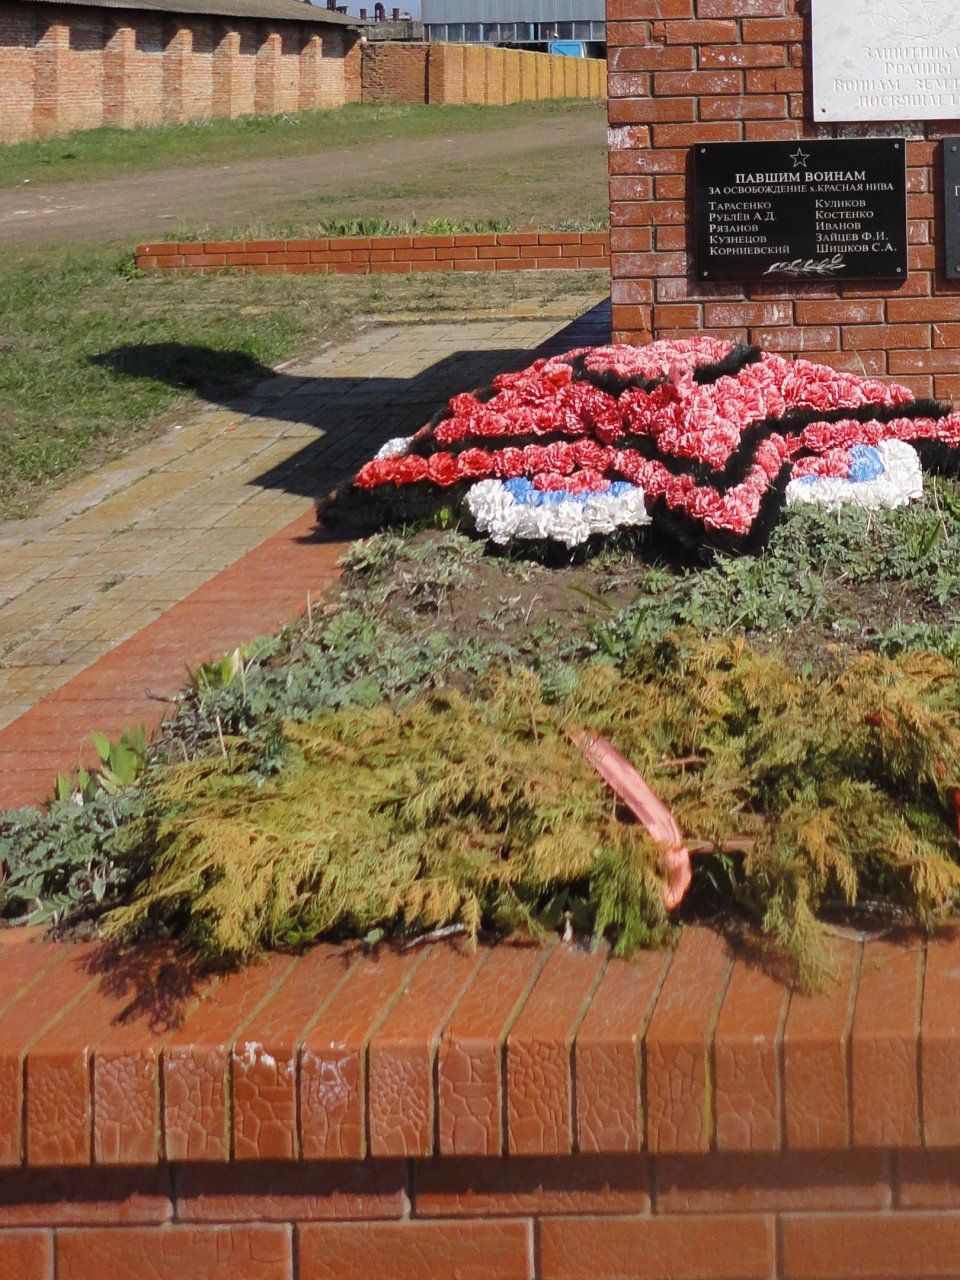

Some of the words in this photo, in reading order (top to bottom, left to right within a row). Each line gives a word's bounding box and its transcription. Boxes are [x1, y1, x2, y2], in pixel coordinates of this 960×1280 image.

[736, 172, 800, 183] ПАВШИМ
[805, 171, 866, 182] ВОИНАМ
[724, 185, 807, 194] ОСВОБОЖДЕНИЕ
[866, 183, 893, 191] НИВА
[708, 202, 771, 210] ТАРАСЕНКО
[815, 199, 866, 208] КУЛИКОВ
[816, 211, 874, 219] КОСТЕНКО
[709, 224, 758, 232] РЯЗАНОВ
[816, 222, 861, 230] ИВАНОВ
[710, 236, 767, 244] КУЗНЕЦОВ
[816, 233, 859, 241] ЗАЙЦЕВ
[862, 232, 888, 241] Ф.И.
[710, 245, 790, 255] КОРНИЕВСКИЙ
[816, 244, 869, 253] ШИШКОВ
[872, 242, 896, 251] С.А.
